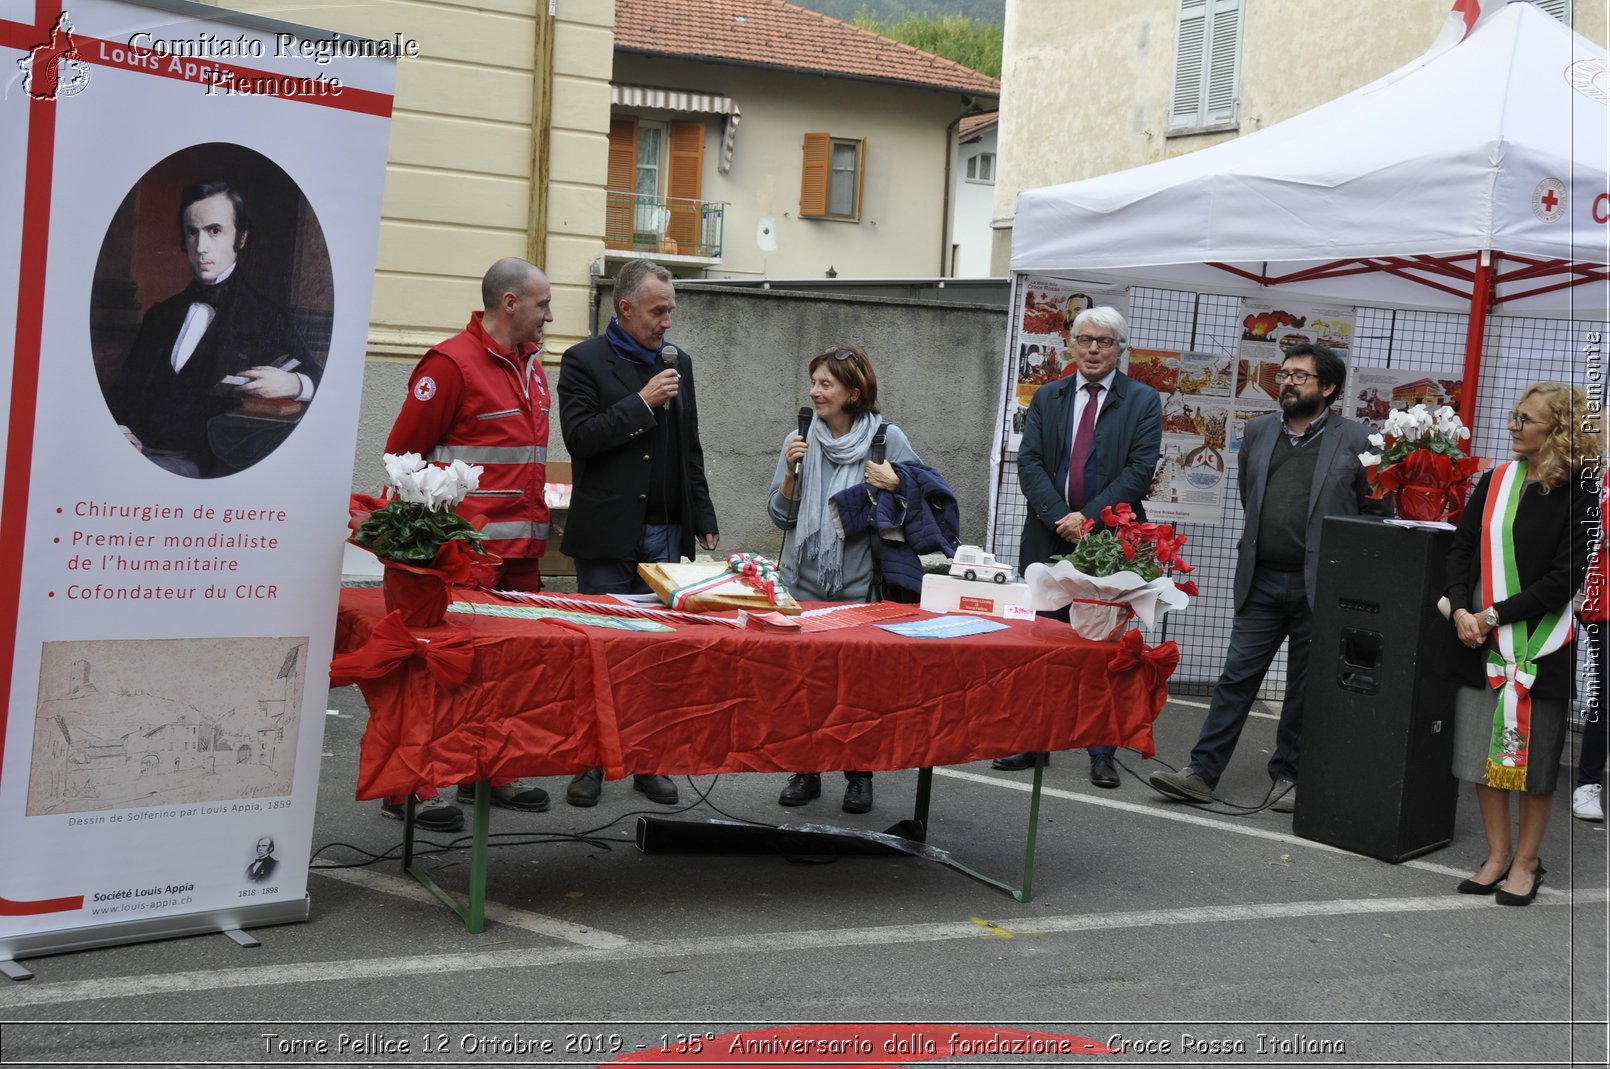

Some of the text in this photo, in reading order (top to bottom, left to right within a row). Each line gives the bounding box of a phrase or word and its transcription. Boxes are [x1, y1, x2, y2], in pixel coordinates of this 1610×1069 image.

[100, 42, 159, 70] Louis
[74, 501, 286, 523] Chirurgien de guerre
[72, 531, 278, 549] Premier mondialiste
[68, 555, 92, 570] de
[67, 584, 278, 599] Cofondateur du CICR
[68, 800, 291, 826] Dessin de Solferino par Louis Appia, 1859
[93, 883, 194, 902] Société Louis Appia
[239, 889, 256, 897] 1818
[262, 887, 279, 895] 1898
[92, 897, 192, 916] www.louis-appia.ch
